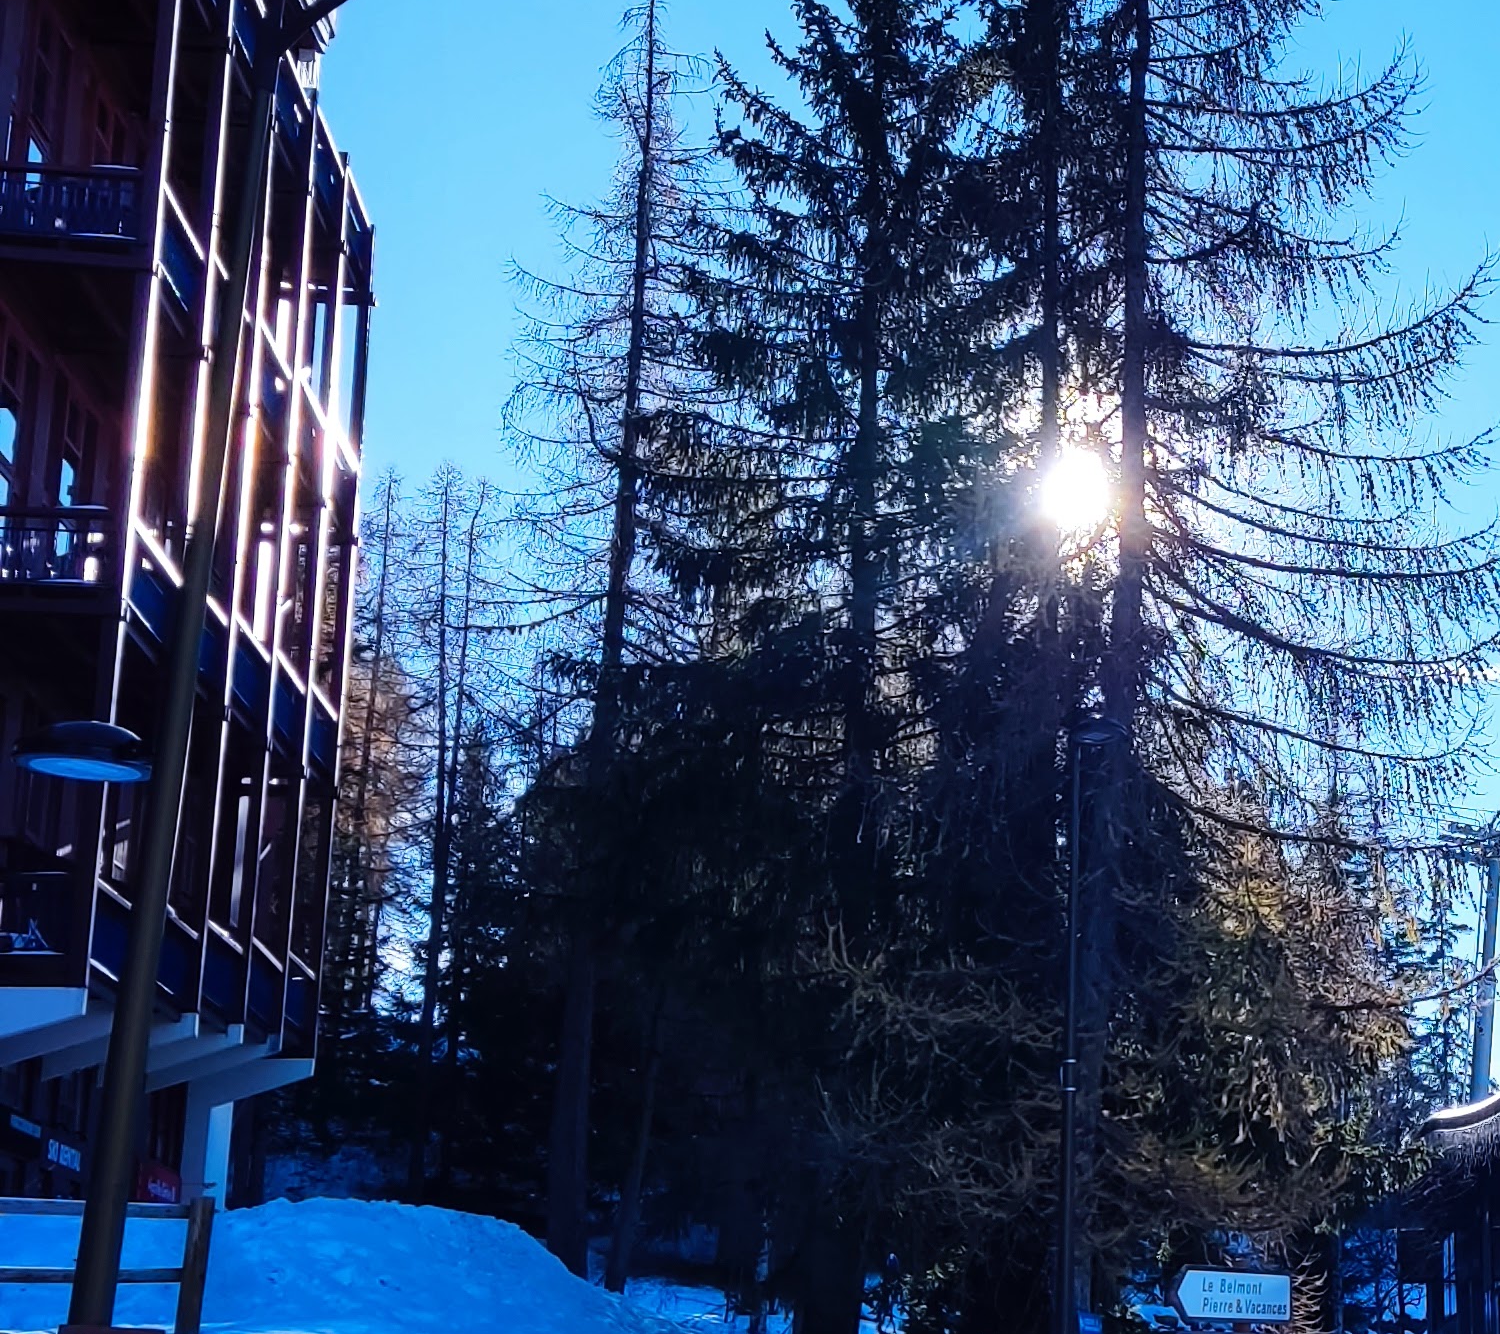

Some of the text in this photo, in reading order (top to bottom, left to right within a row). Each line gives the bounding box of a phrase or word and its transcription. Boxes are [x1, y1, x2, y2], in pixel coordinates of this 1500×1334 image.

[1202, 1277, 1262, 1295] Le Belmont
[1202, 1297, 1287, 1315] Pierre & Vacances
